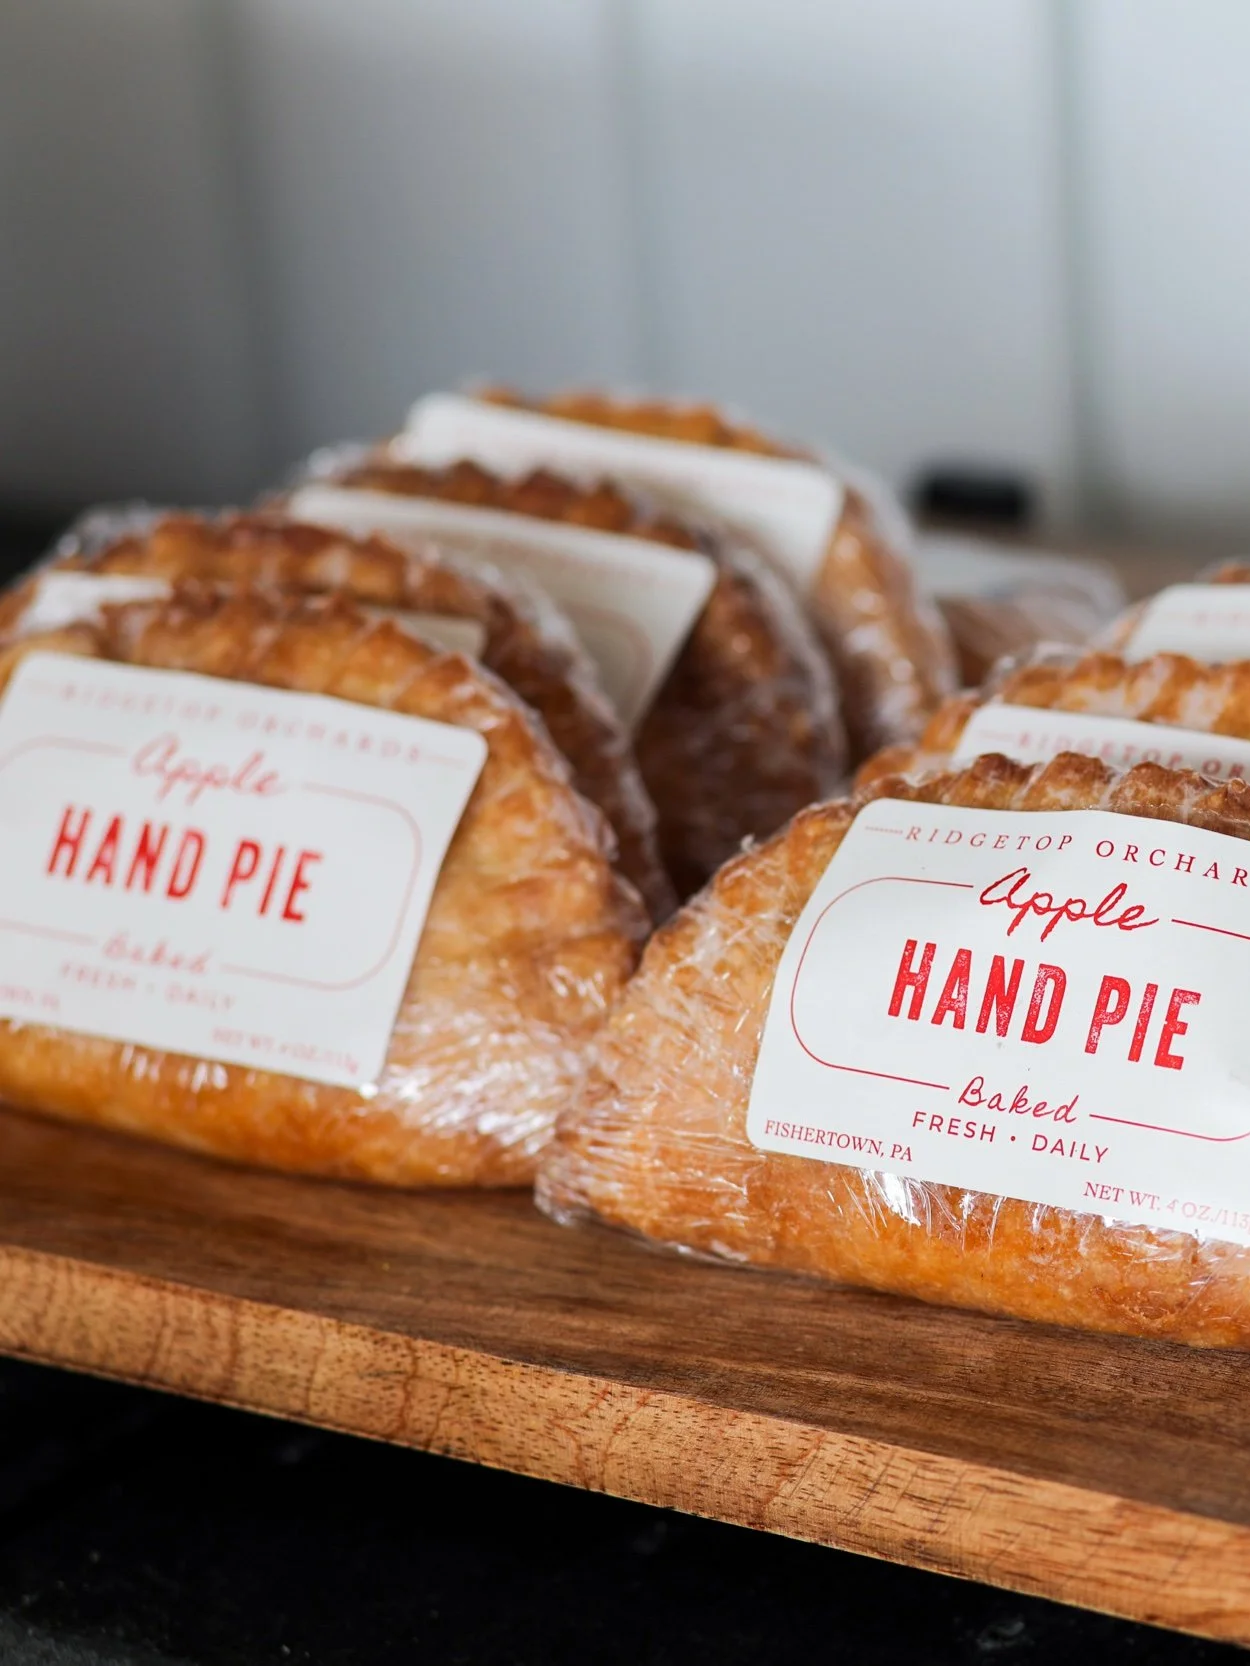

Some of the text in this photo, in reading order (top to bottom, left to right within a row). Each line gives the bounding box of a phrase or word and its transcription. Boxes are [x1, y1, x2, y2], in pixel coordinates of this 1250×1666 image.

[132, 733, 284, 804] Apple
[46, 803, 324, 926] HAND PIE
[904, 824, 1075, 853] RIDGETOP
[978, 866, 1160, 943] Apple
[887, 938, 1203, 1071] HAND PIE
[957, 1075, 1080, 1125] Baked
[763, 1118, 914, 1163] FISHERTOWN, PA
[911, 1110, 1110, 1165] FRESH DAILY
[1083, 1181, 1125, 1203] NET
[1129, 1189, 1161, 1212] WT.
